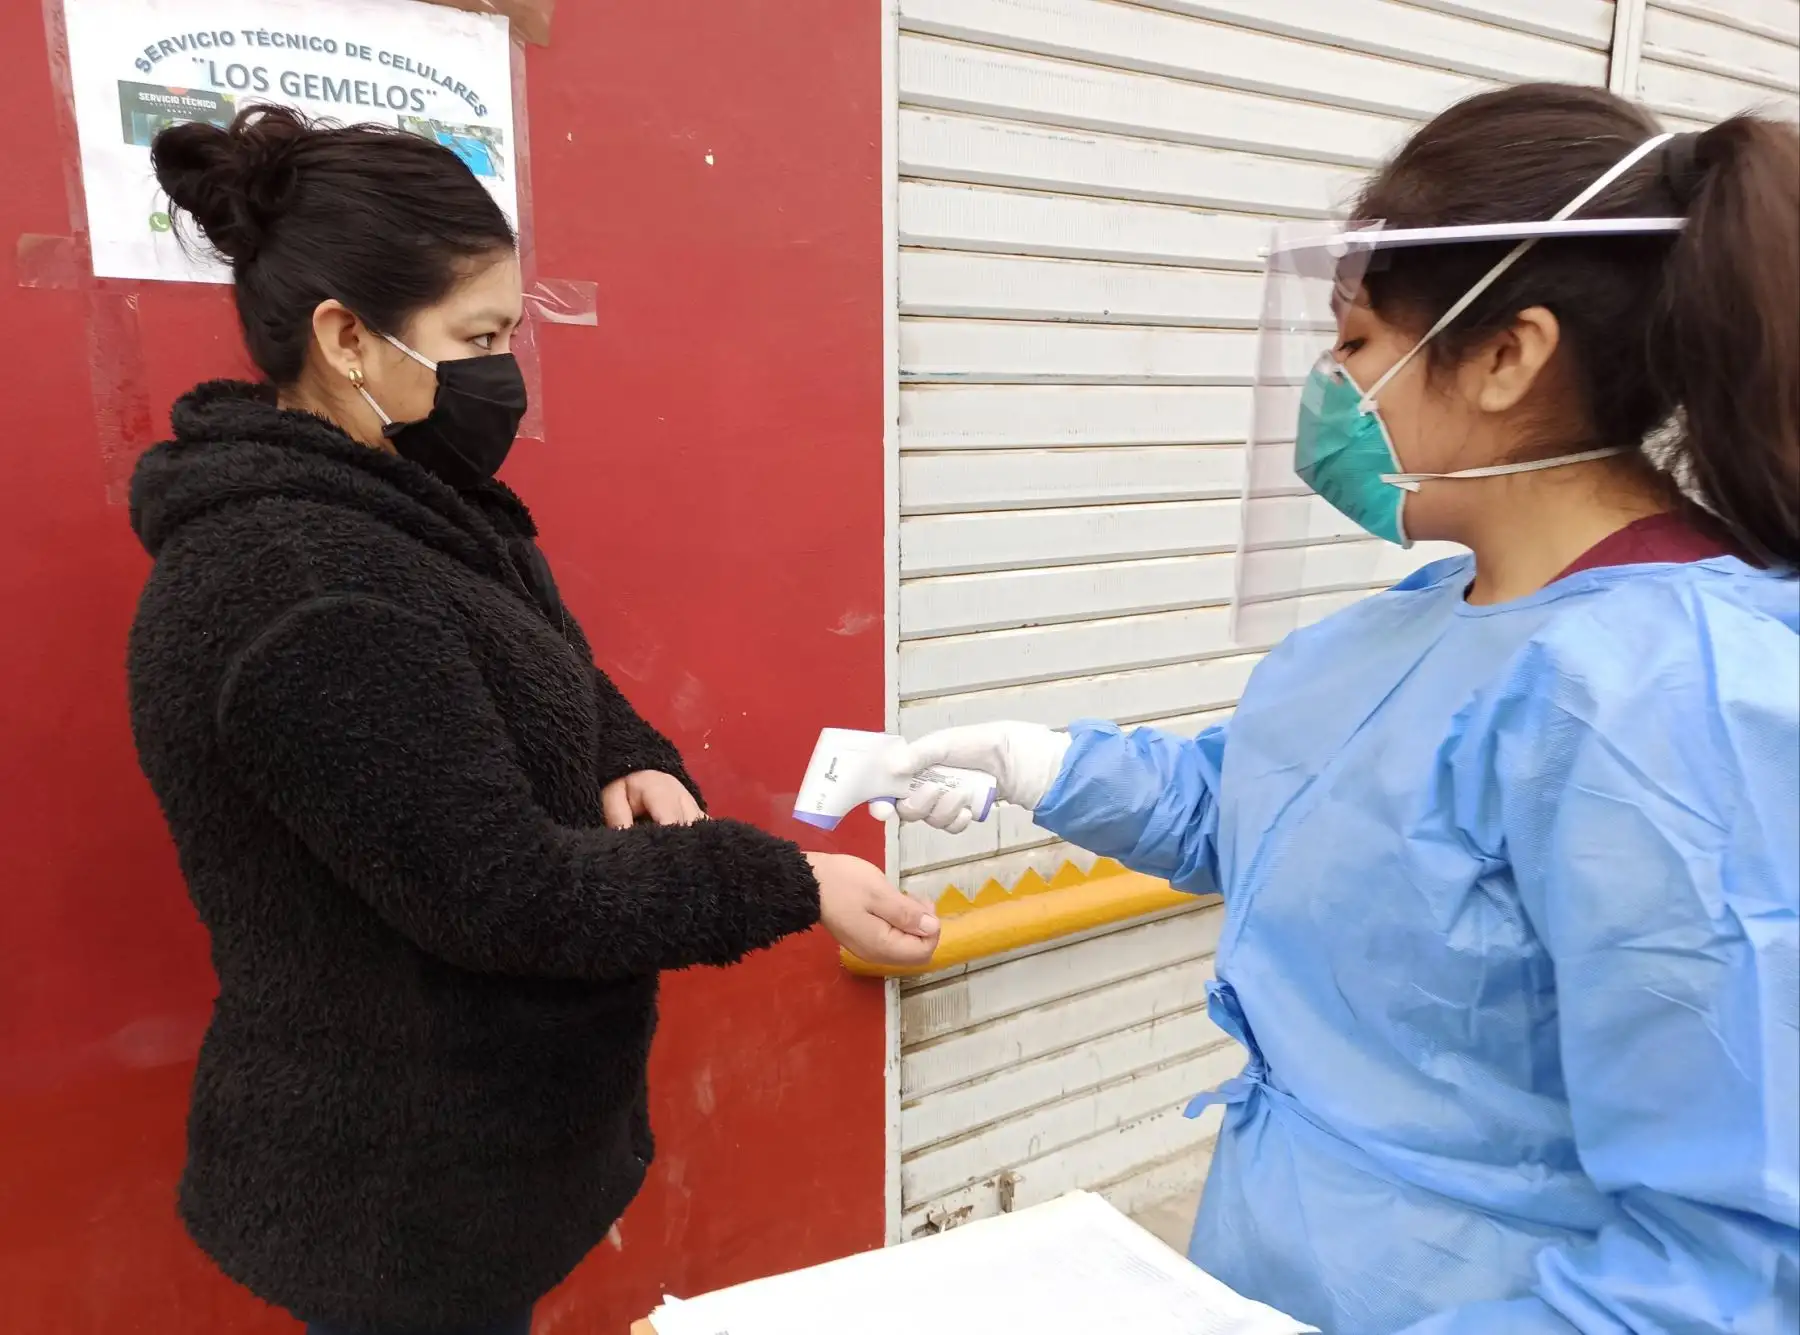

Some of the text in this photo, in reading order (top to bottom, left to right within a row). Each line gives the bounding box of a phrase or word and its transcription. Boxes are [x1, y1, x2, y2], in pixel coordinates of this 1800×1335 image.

[135, 28, 488, 118] SERVICIO TÉCNICO DE CELULARES
[138, 91, 180, 105] SERVICIO
